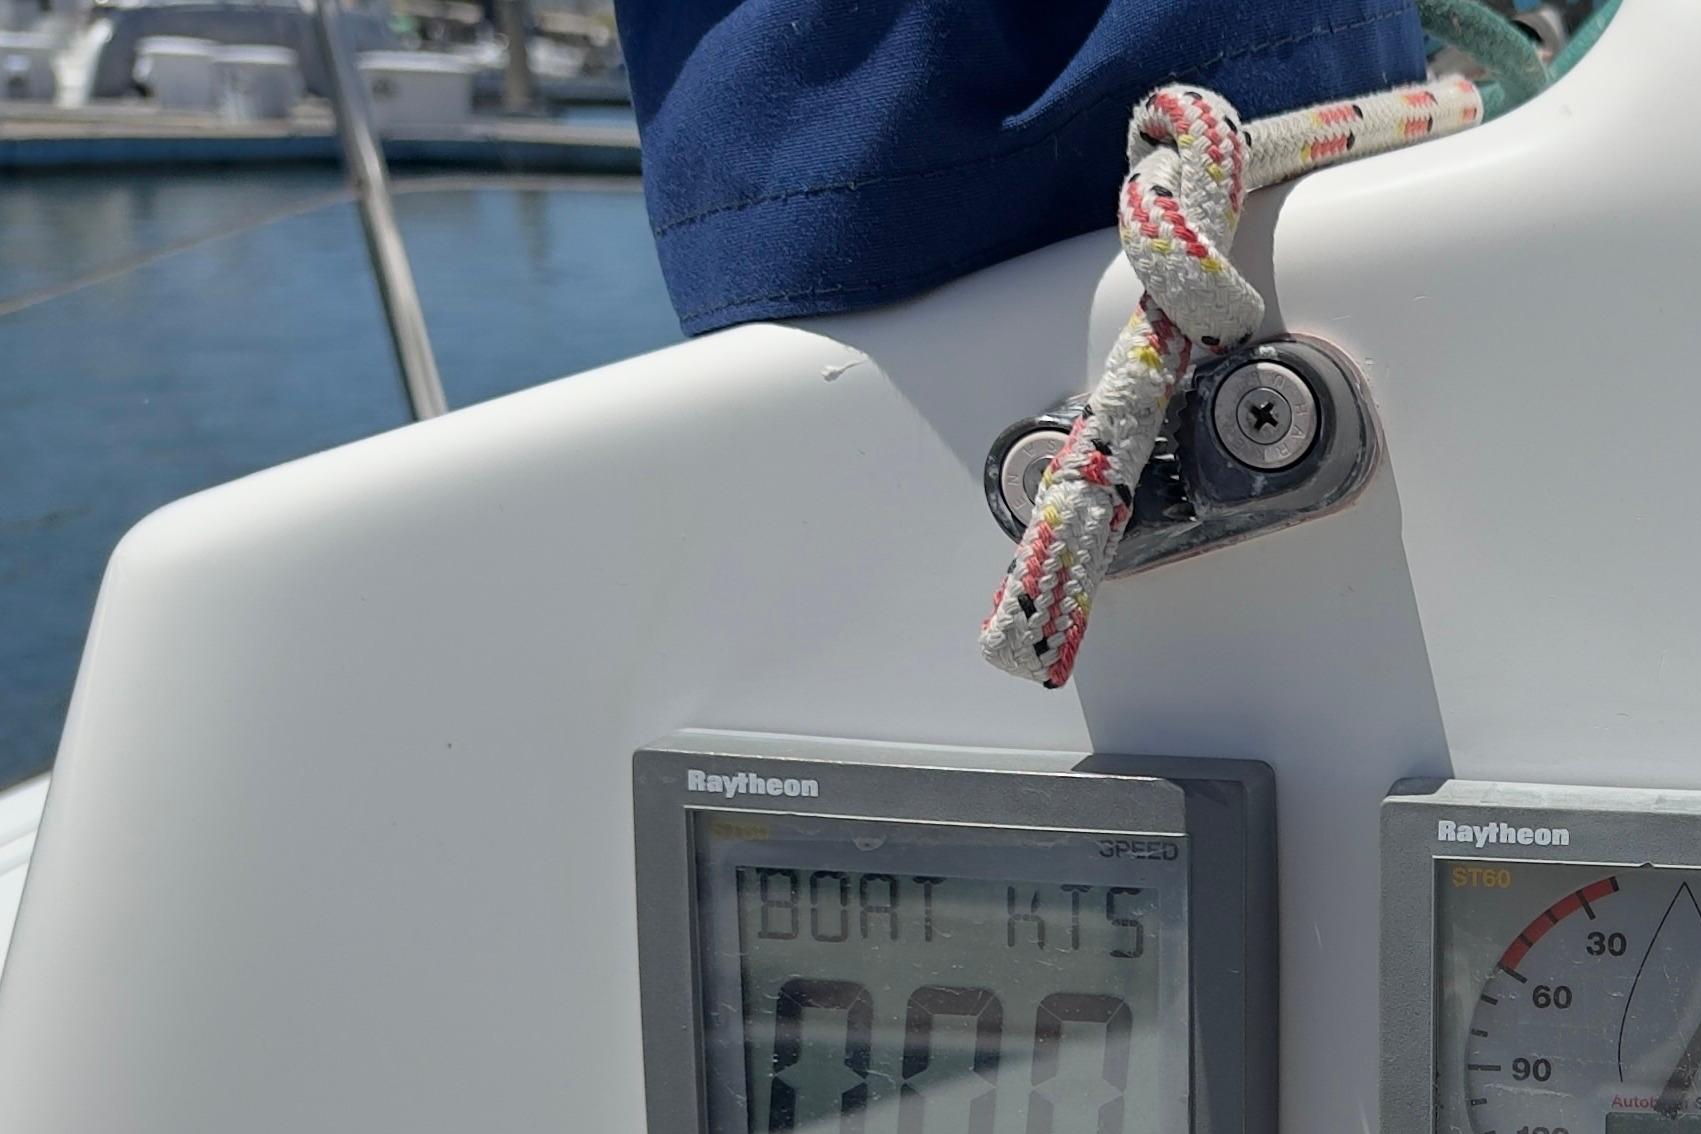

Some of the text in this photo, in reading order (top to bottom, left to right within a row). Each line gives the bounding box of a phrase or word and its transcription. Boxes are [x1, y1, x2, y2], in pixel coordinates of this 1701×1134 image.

[687, 769, 819, 799] Raytheon
[1437, 819, 1570, 848] Raytheon
[1099, 839, 1179, 862] SPEED
[1451, 868, 1512, 889] ST60
[757, 867, 1146, 960] BOAT KTS
[1586, 932, 1627, 957] 30
[1532, 985, 1572, 1009] 60
[1511, 1058, 1552, 1082] 90
